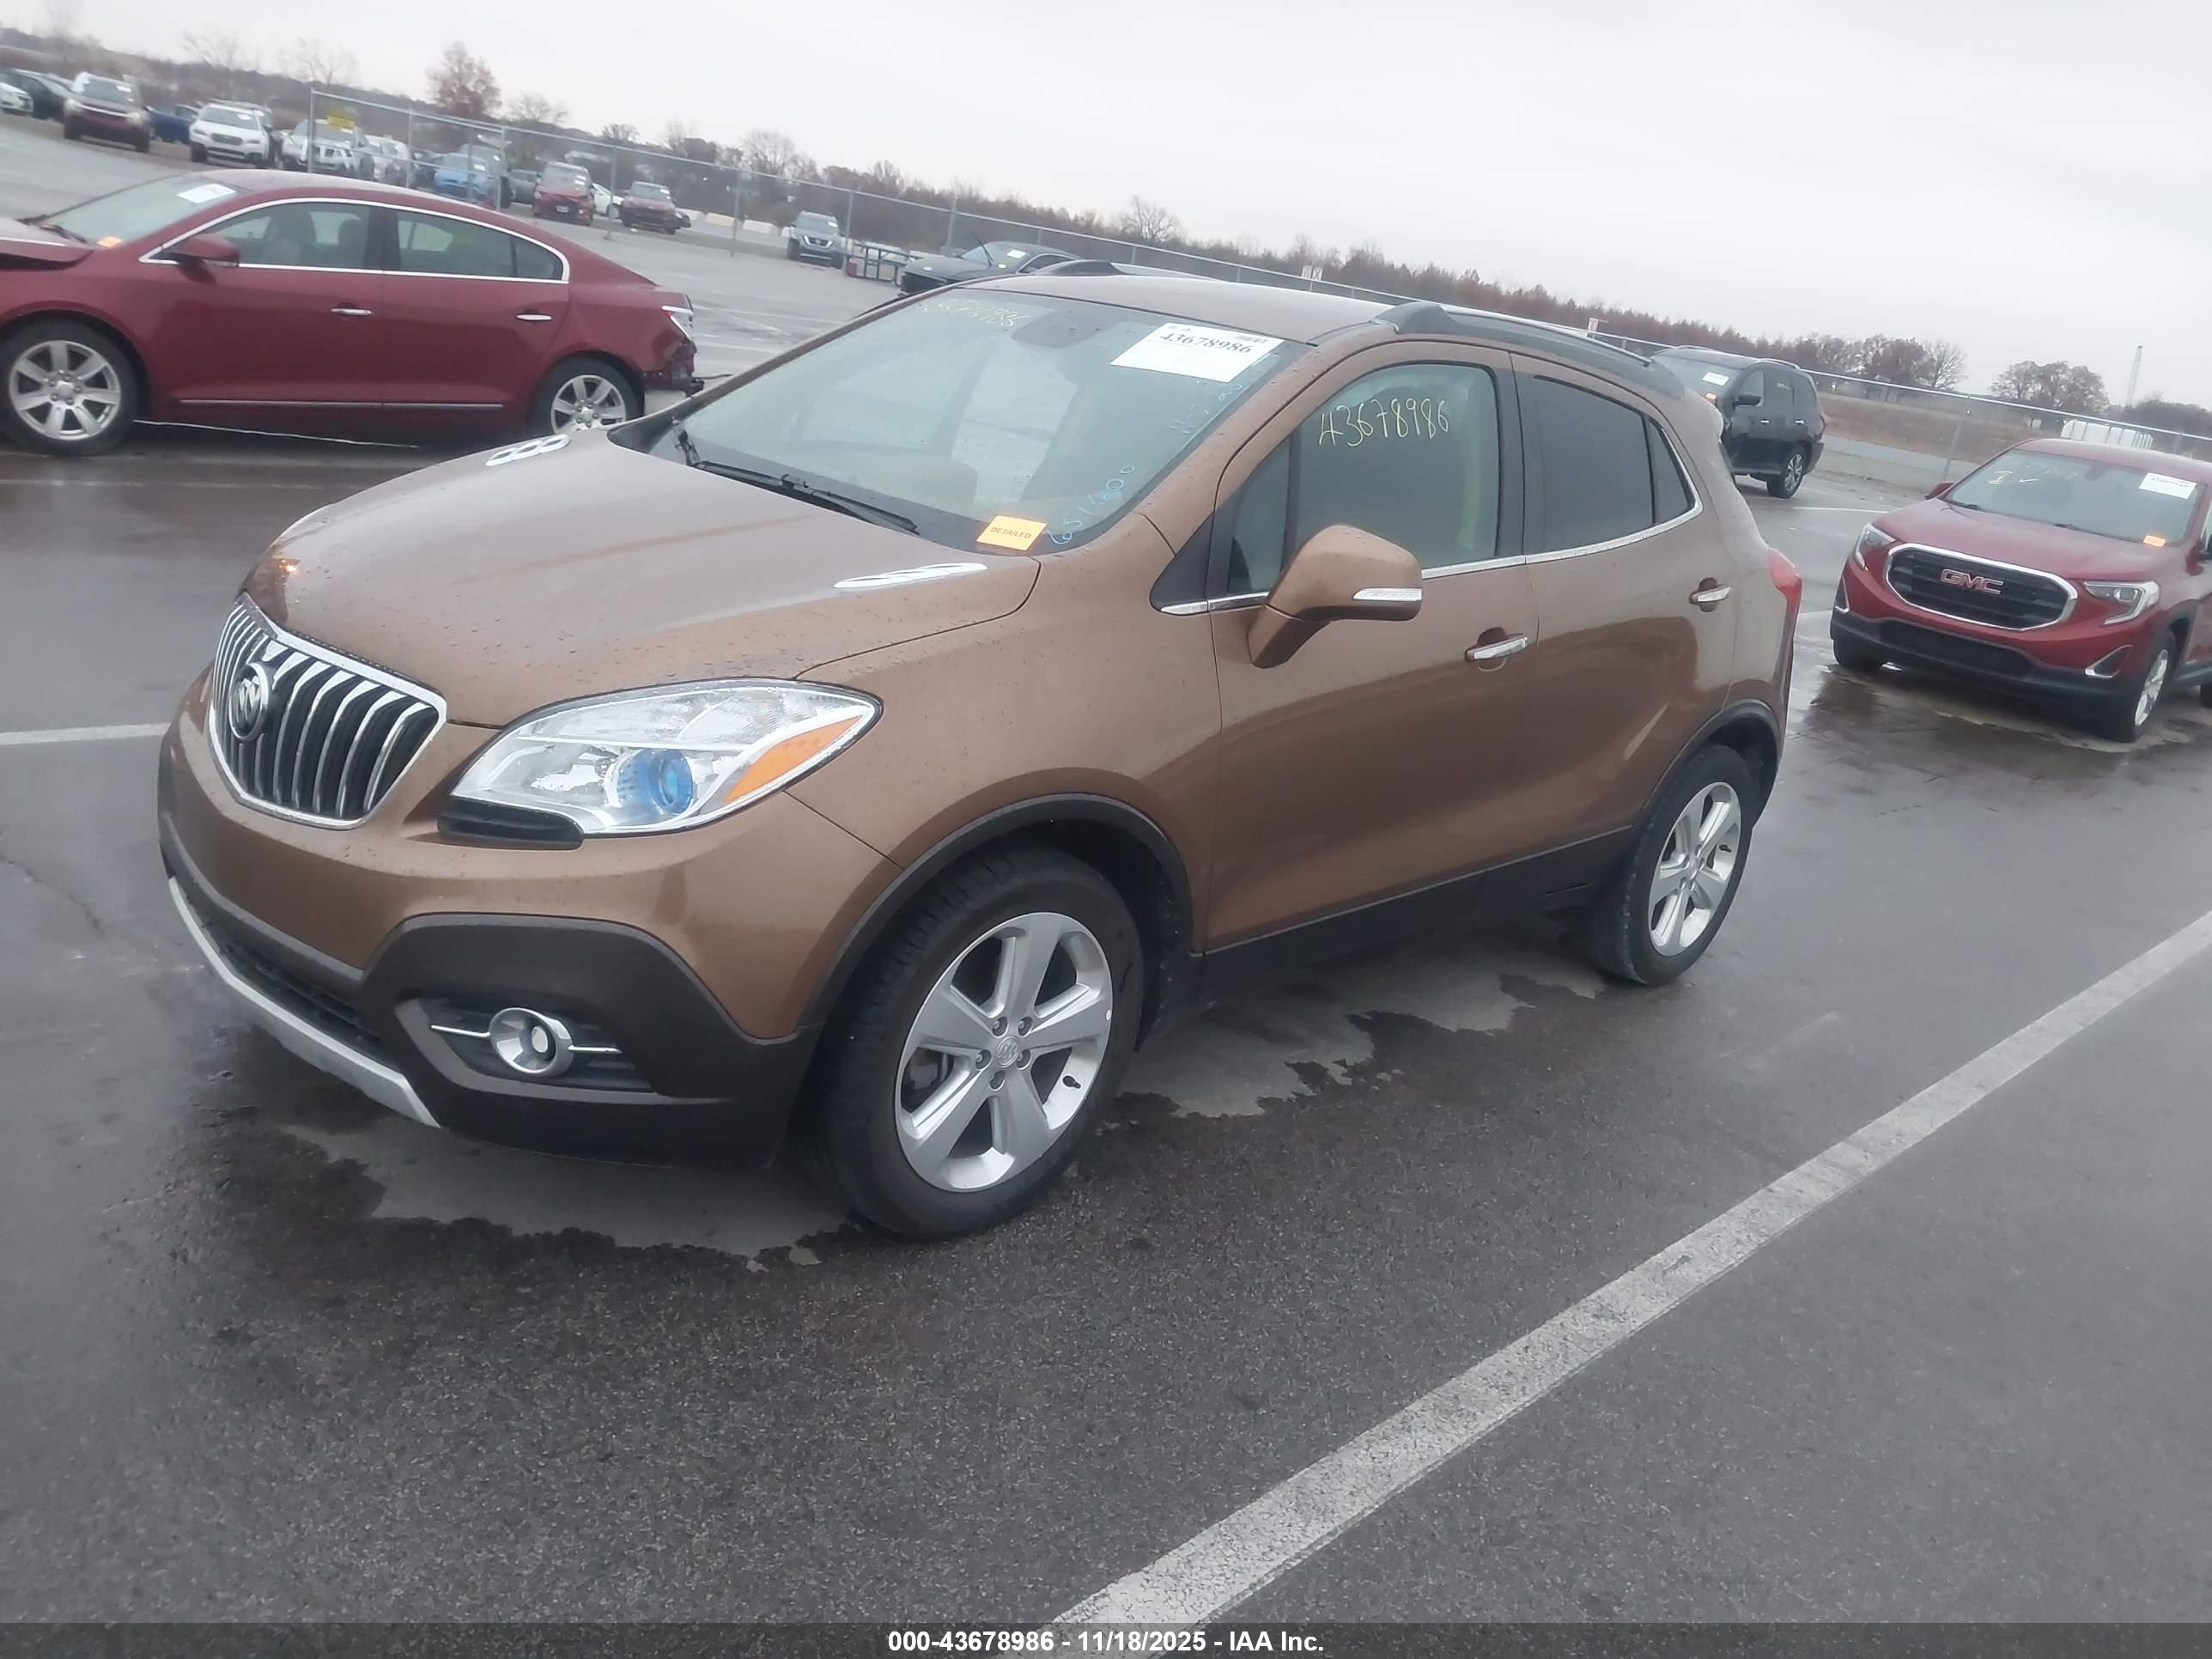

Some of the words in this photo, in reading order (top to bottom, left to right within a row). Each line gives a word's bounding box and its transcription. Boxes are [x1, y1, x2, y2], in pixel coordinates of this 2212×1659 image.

[1159, 332, 1255, 354] 43678986
[1318, 398, 1449, 447] 43678986
[989, 526, 1032, 539] DETAILED
[1939, 568, 2005, 595] GMC
